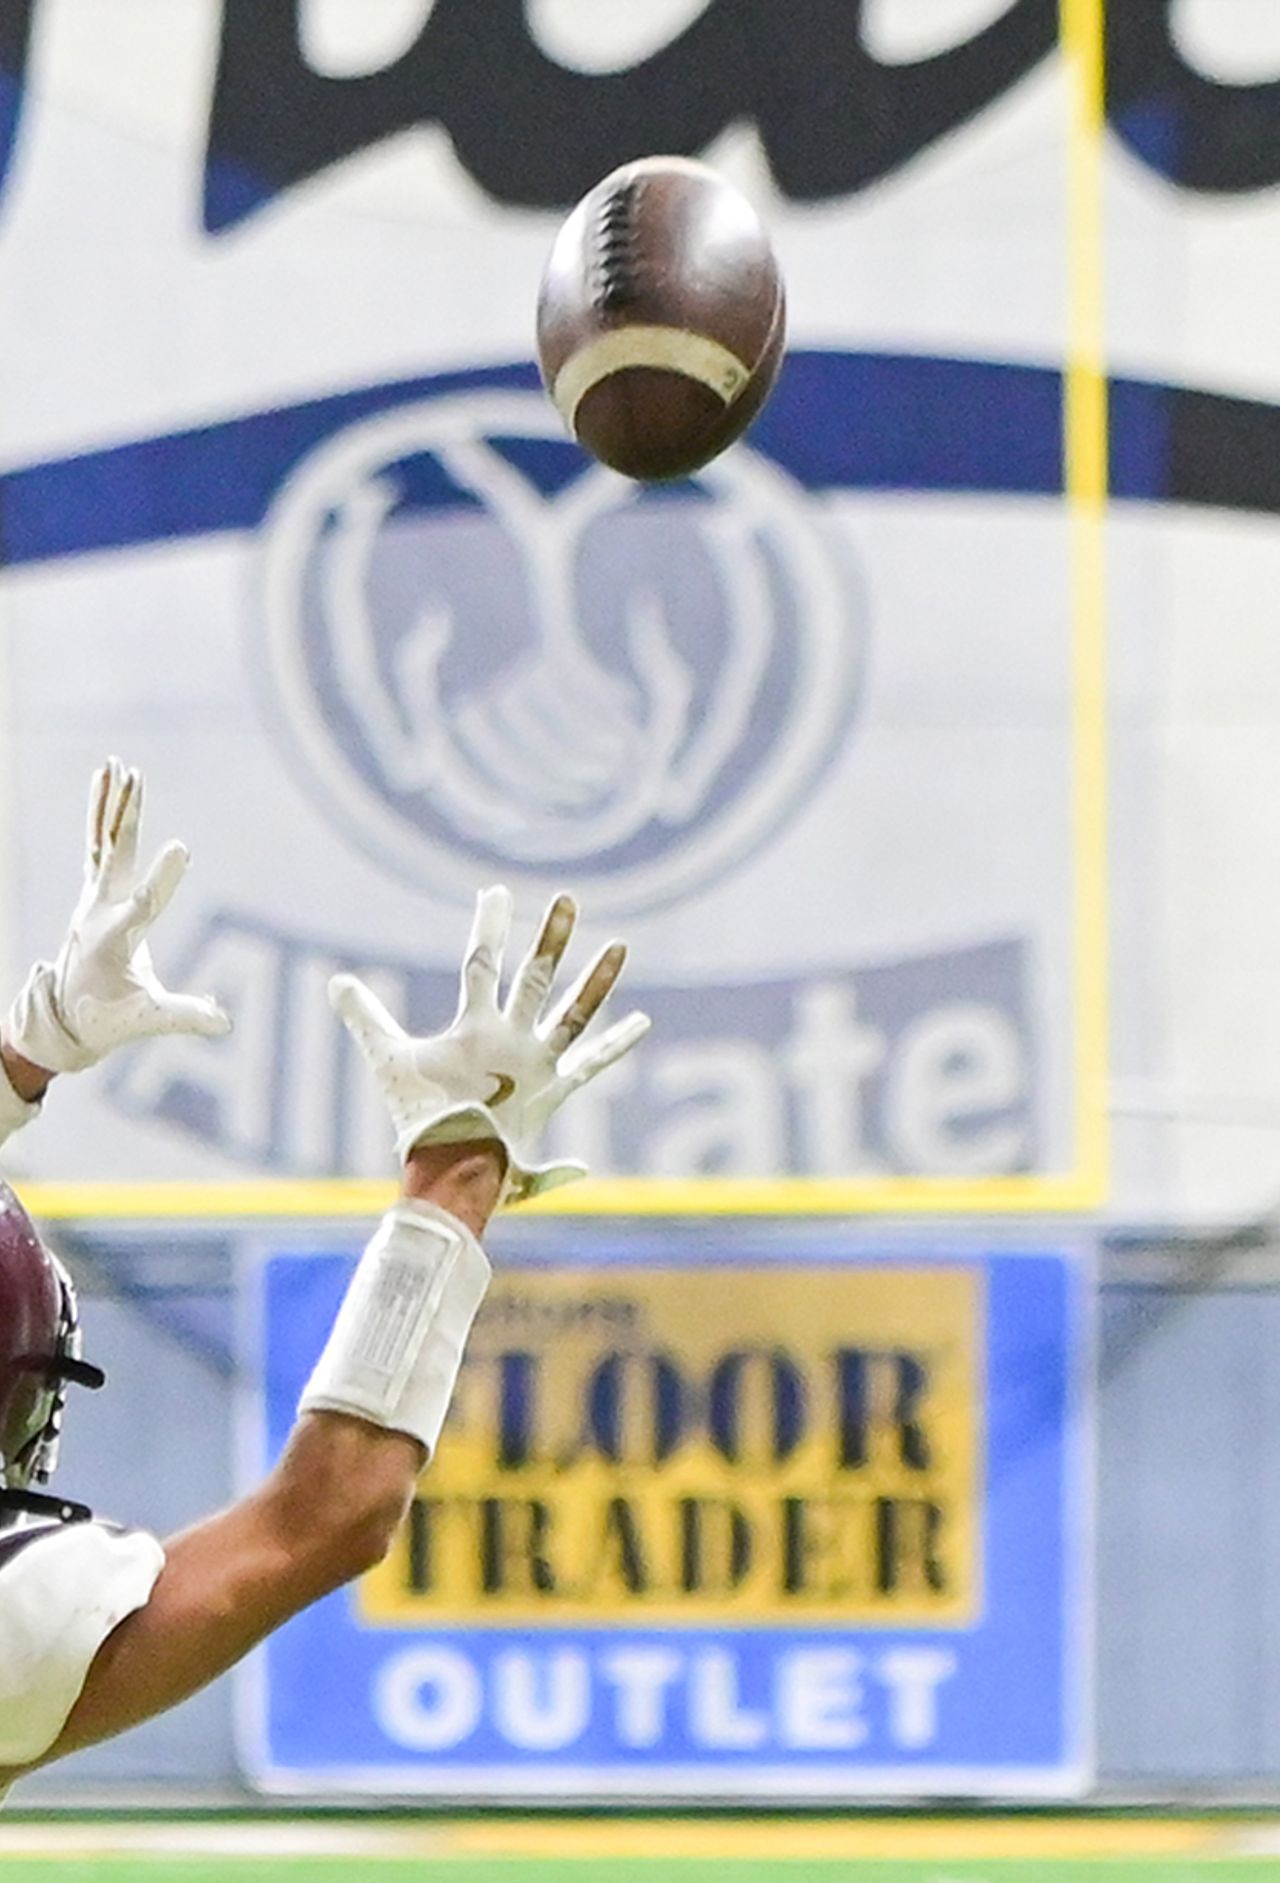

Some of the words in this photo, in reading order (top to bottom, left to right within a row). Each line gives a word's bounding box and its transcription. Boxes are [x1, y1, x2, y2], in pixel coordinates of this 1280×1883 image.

[443, 1347, 932, 1472] LOOR
[402, 1496, 946, 1596] TRADER
[373, 1644, 958, 1752] OUTLET
